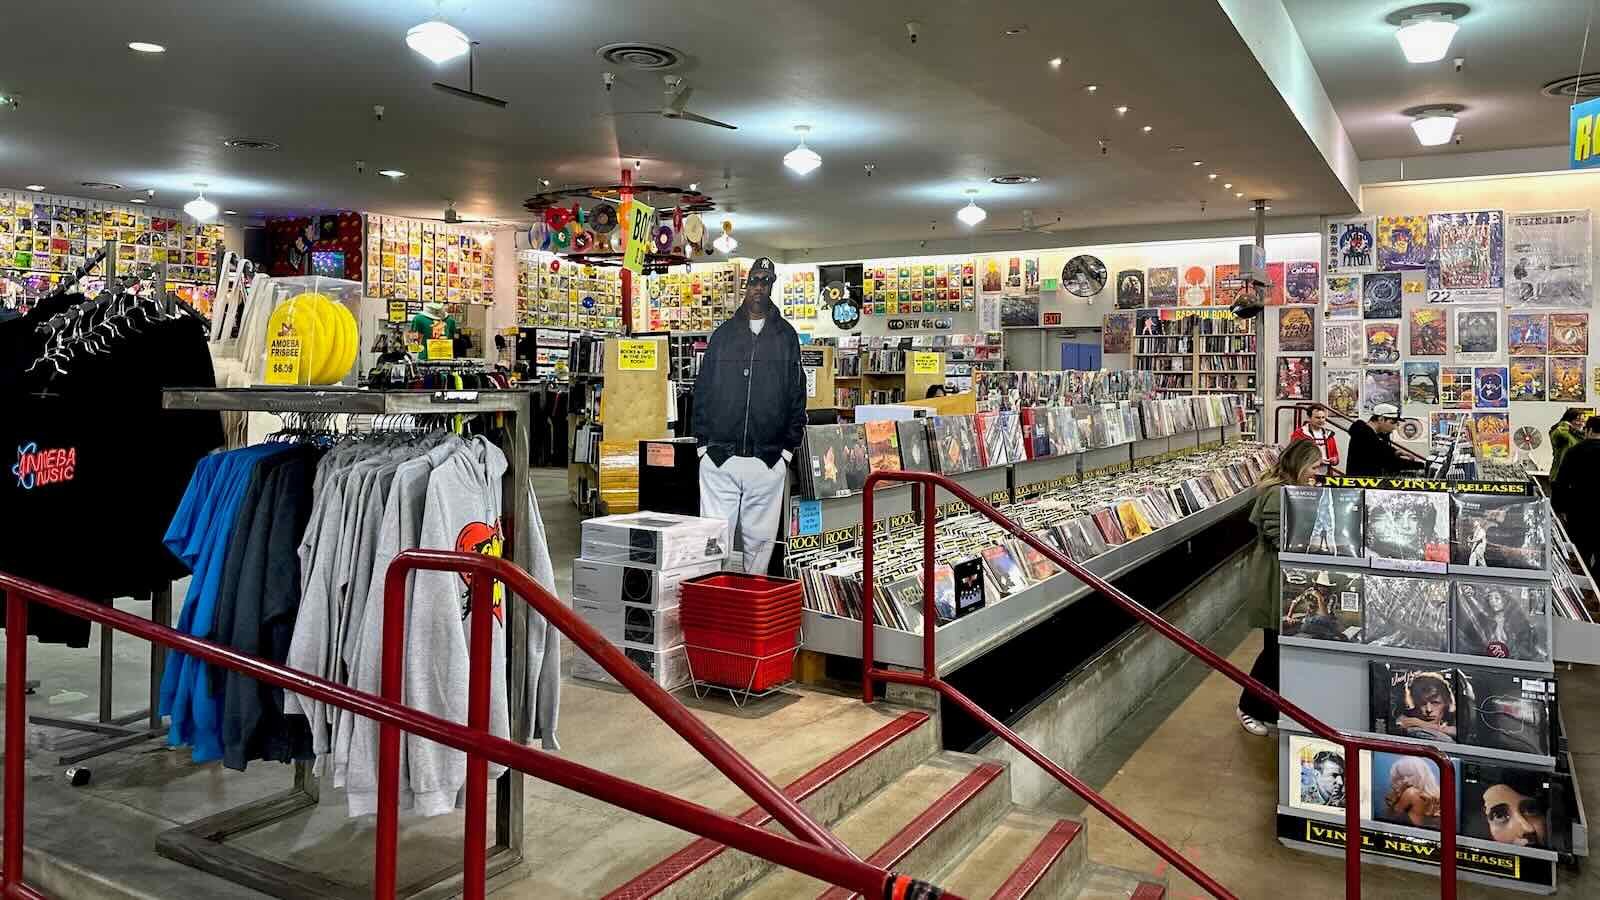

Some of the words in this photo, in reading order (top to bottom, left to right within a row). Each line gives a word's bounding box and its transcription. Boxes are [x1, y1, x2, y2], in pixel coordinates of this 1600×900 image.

[1044, 314, 1061, 325] EXIT
[1212, 310, 1235, 320] BOOK
[904, 319, 920, 329] NEW
[271, 339, 300, 348] AMOEBA
[271, 348, 300, 357] FRISBEE
[1324, 476, 1383, 488] NEW
[1390, 479, 1452, 491] VINYL
[1455, 482, 1525, 494] RELEASES
[890, 513, 914, 528] ROCK
[789, 535, 820, 550] ROCK
[825, 528, 853, 544] ROCK
[1311, 826, 1375, 846] VINL
[1384, 839, 1436, 856] NEW
[1456, 853, 1514, 869] ELEASES
